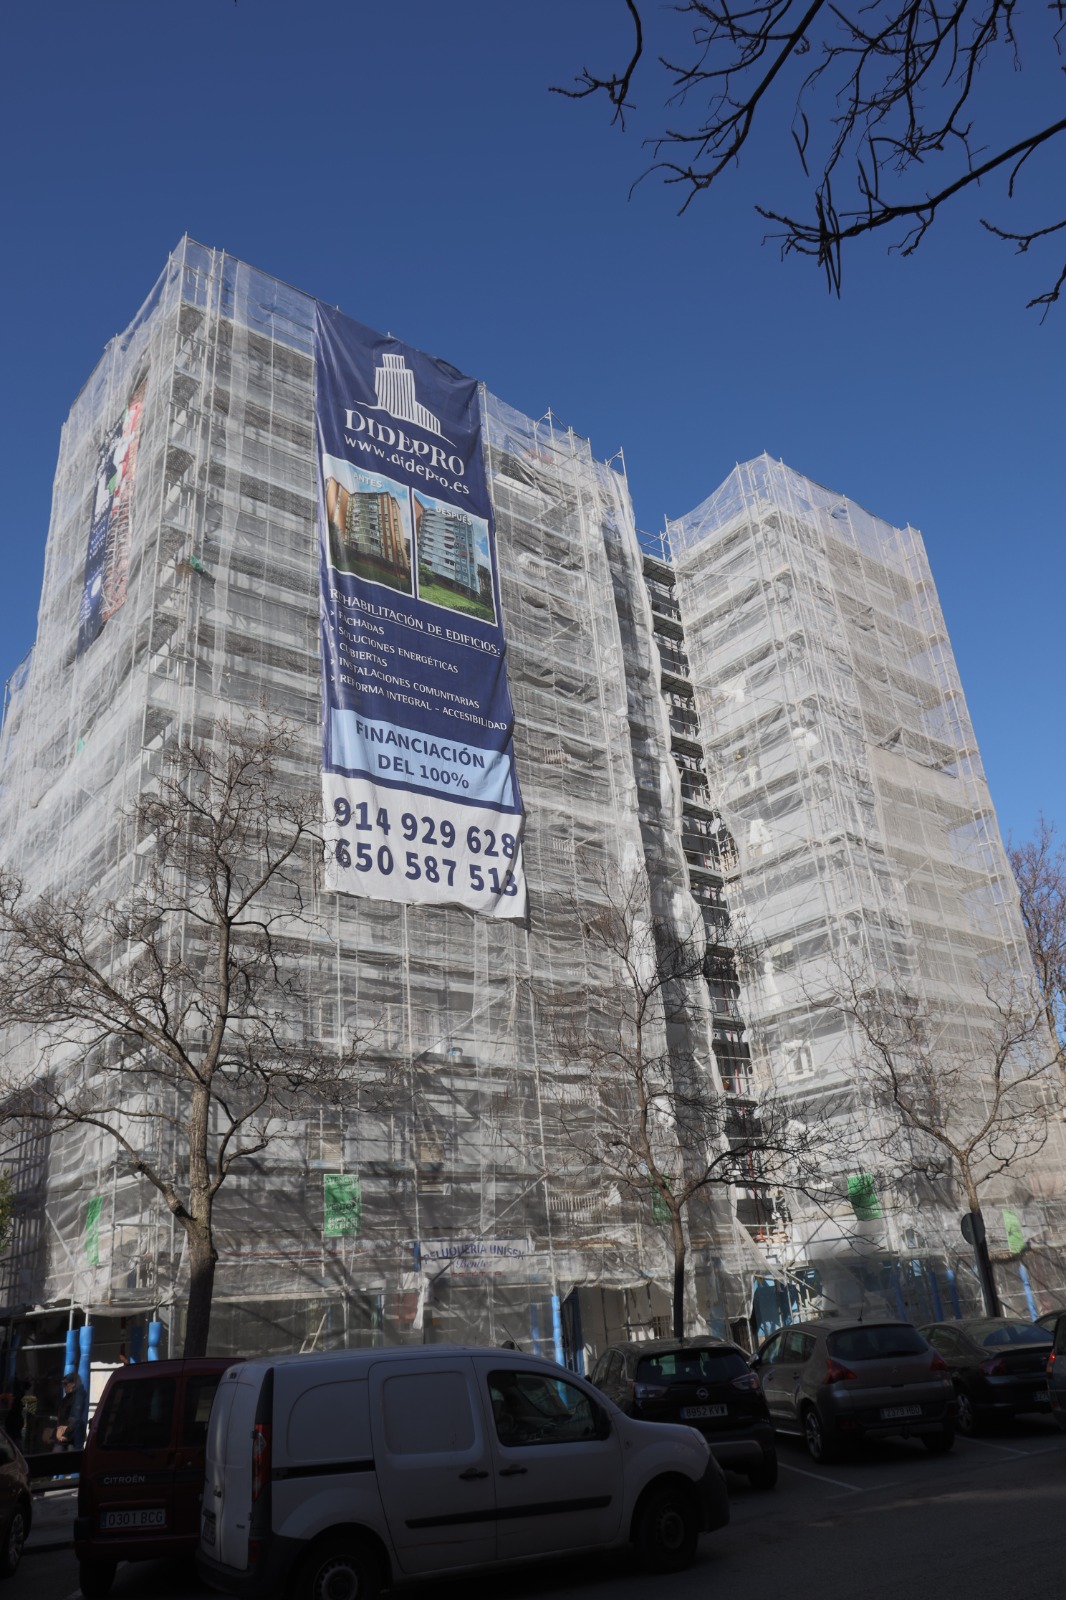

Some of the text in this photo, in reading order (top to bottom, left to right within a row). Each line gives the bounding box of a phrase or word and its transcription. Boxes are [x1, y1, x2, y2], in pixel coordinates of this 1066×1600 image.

[343, 433, 470, 495] www.didepro.es
[345, 408, 465, 476] DIDEPRO
[354, 472, 383, 489] ANTES
[338, 611, 385, 635] FACHADAS
[427, 623, 443, 636] DE
[445, 629, 501, 656] EDIFICIOS:
[338, 626, 459, 674] SOLUCIONES ENERGÉTICAS
[339, 642, 388, 667] CUBIERTAS
[339, 657, 480, 709] INSTALACIONES COMUNITARIAS
[340, 674, 385, 696] REFORMA
[386, 690, 432, 711] INTEGRAL
[442, 707, 507, 730] ACCESIBILIDAD
[355, 719, 485, 769] FINANCIACIÓN
[378, 754, 470, 789] DEL 100%
[333, 797, 516, 859] 914 929 628
[335, 838, 394, 876] 650
[405, 851, 457, 887] 587
[103, 1474, 146, 1485] CITROËN
[108, 1513, 137, 1526] 0301
